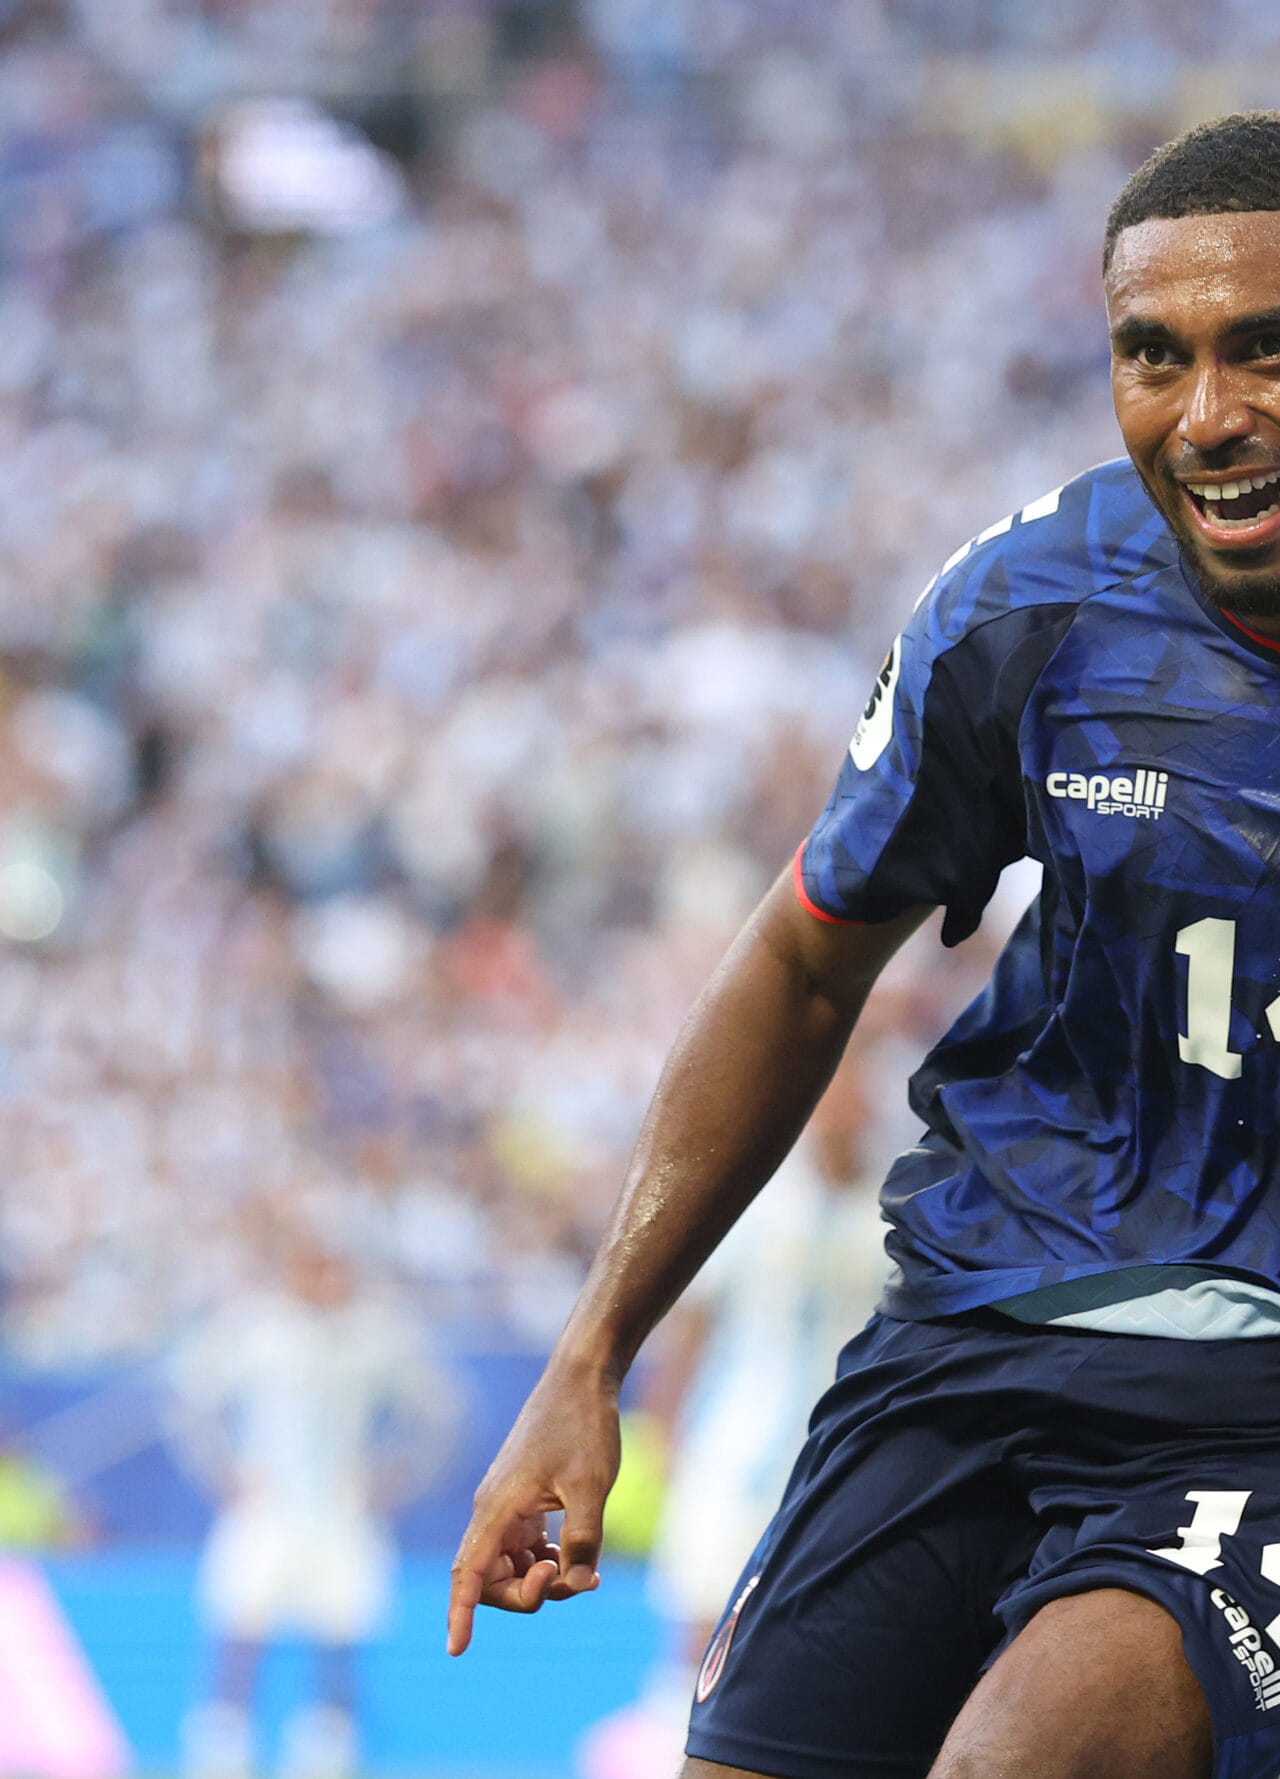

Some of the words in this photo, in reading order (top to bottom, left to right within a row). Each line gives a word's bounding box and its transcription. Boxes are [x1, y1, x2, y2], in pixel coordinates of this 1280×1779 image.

[1046, 769, 1168, 809] capelli
[1097, 802, 1164, 820] SPORT
[1232, 1645, 1266, 1712] SPORT
